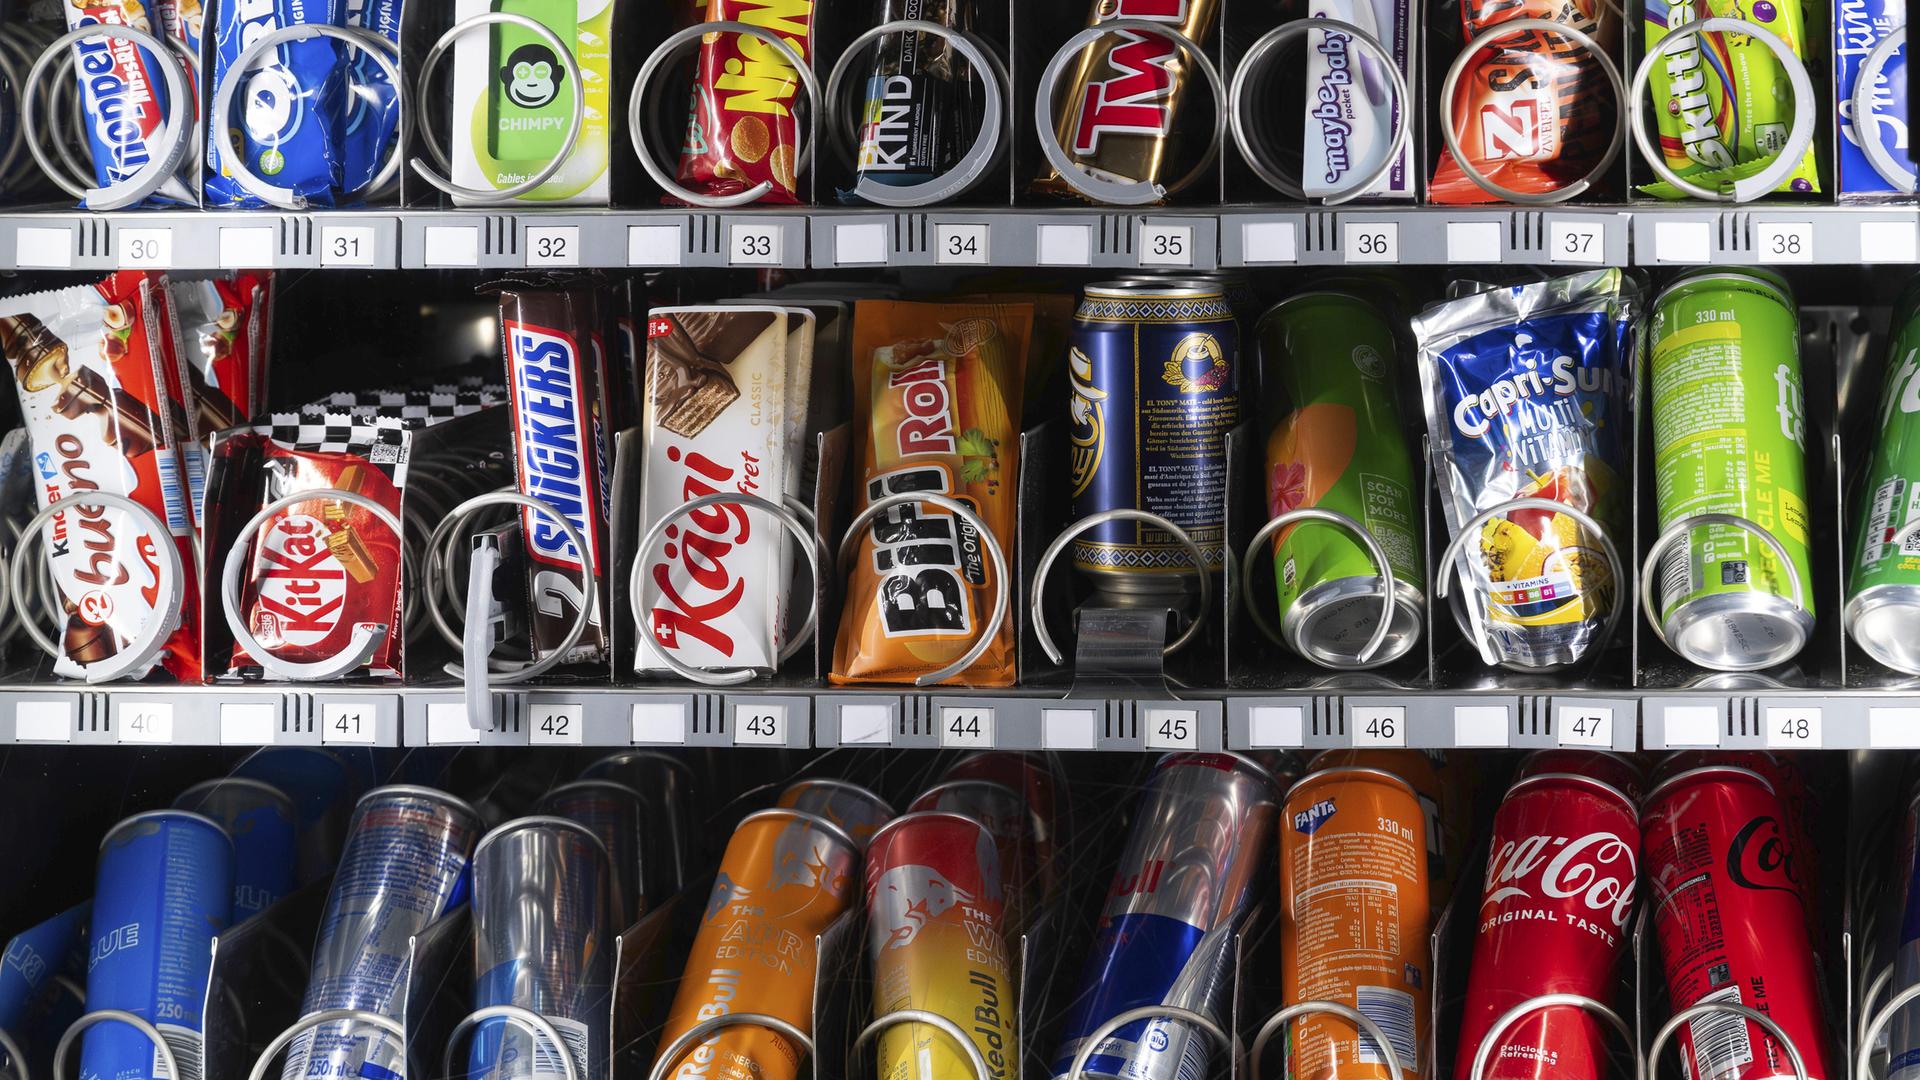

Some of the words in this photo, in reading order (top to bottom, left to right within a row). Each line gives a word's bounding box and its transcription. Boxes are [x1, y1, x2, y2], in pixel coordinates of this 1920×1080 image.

[903, 34, 916, 62] DARK
[1740, 52, 1753, 92] rainbow
[1342, 88, 1356, 119] pocket
[499, 117, 565, 131] CHIMPY
[867, 75, 914, 172] KIND
[1540, 96, 1554, 154] ZWEIFEL
[496, 173, 525, 184] Cables
[131, 239, 160, 259] 30
[334, 237, 361, 258] 31
[537, 237, 566, 258] 32
[742, 236, 771, 256] 33
[948, 235, 978, 256] 34
[1153, 235, 1183, 256] 35
[1358, 234, 1388, 254] 36
[1565, 233, 1594, 253] 37
[1772, 234, 1801, 254] 38
[1695, 309, 1717, 324] 330
[1720, 309, 1737, 322] ml
[750, 372, 762, 427] CLASSIC
[889, 360, 956, 457] Roll
[515, 334, 591, 558] SNICKERS
[1754, 450, 1771, 484] ME
[1367, 481, 1402, 499] SCAN
[1368, 492, 1396, 508] FOR
[73, 433, 131, 586] bueno
[1369, 504, 1408, 524] MORE
[652, 446, 751, 659] Kägi
[259, 520, 345, 632] KitKat
[963, 549, 982, 584] The
[1512, 578, 1550, 589] VITAMINS
[131, 713, 160, 734] 40
[335, 713, 361, 734] 41
[540, 715, 570, 735] 42
[746, 715, 776, 735] 43
[950, 717, 981, 737] 44
[1158, 719, 1188, 739] 45
[1366, 718, 1395, 738] 46
[1572, 717, 1601, 737] 47
[1781, 719, 1810, 739] 48
[1294, 800, 1336, 830] FANTA
[1377, 816, 1399, 835] 330
[1401, 826, 1414, 843] ml
[962, 906, 992, 924] THE
[1480, 909, 1558, 934] ORIGINAL
[1566, 914, 1616, 948] TASTE
[715, 945, 793, 977] EDITION
[697, 968, 741, 1022] Bull
[1750, 975, 1766, 999] ME
[968, 970, 1001, 1028] Bull
[157, 1002, 183, 1019] 250
[1150, 1035, 1165, 1047] alu
[1500, 1044, 1549, 1056] Delicious
[1500, 1051, 1557, 1066] Refreshing
